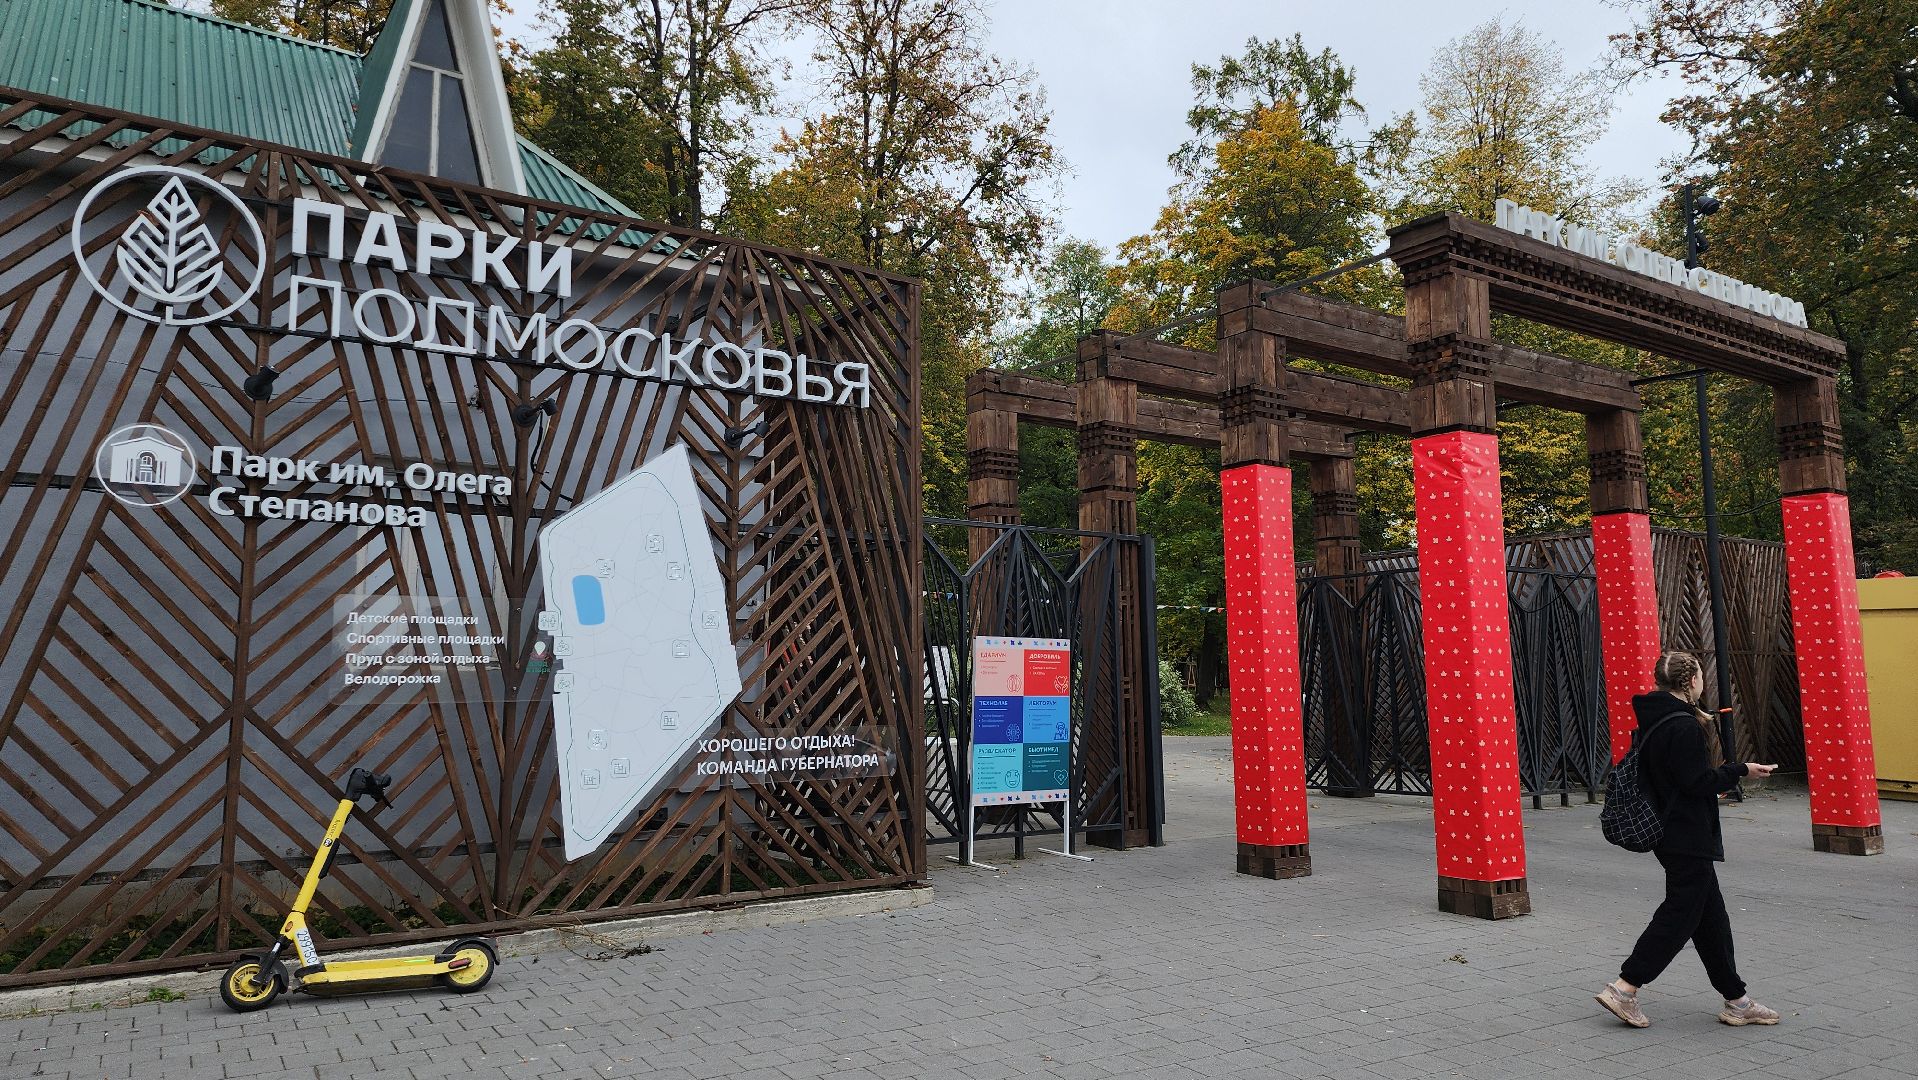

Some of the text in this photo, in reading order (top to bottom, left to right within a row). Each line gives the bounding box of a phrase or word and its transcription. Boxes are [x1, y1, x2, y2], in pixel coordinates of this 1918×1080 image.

[292, 197, 572, 298] ПАРКИ
[288, 275, 870, 409] ПОДМОСКОВЬЯ
[212, 446, 513, 496] Парк им. Олега
[208, 486, 427, 528] Степанова
[347, 612, 479, 627] Детские площадки
[346, 632, 505, 647] Спортивные площадки
[345, 653, 490, 666] Пруд с зоной отдыха
[344, 674, 441, 685] Велодорожка
[697, 735, 855, 753] ХОРОШЕГО ОТДЫХА!
[697, 753, 879, 776] КОМАНДА ГУБЕРНАТОРА
